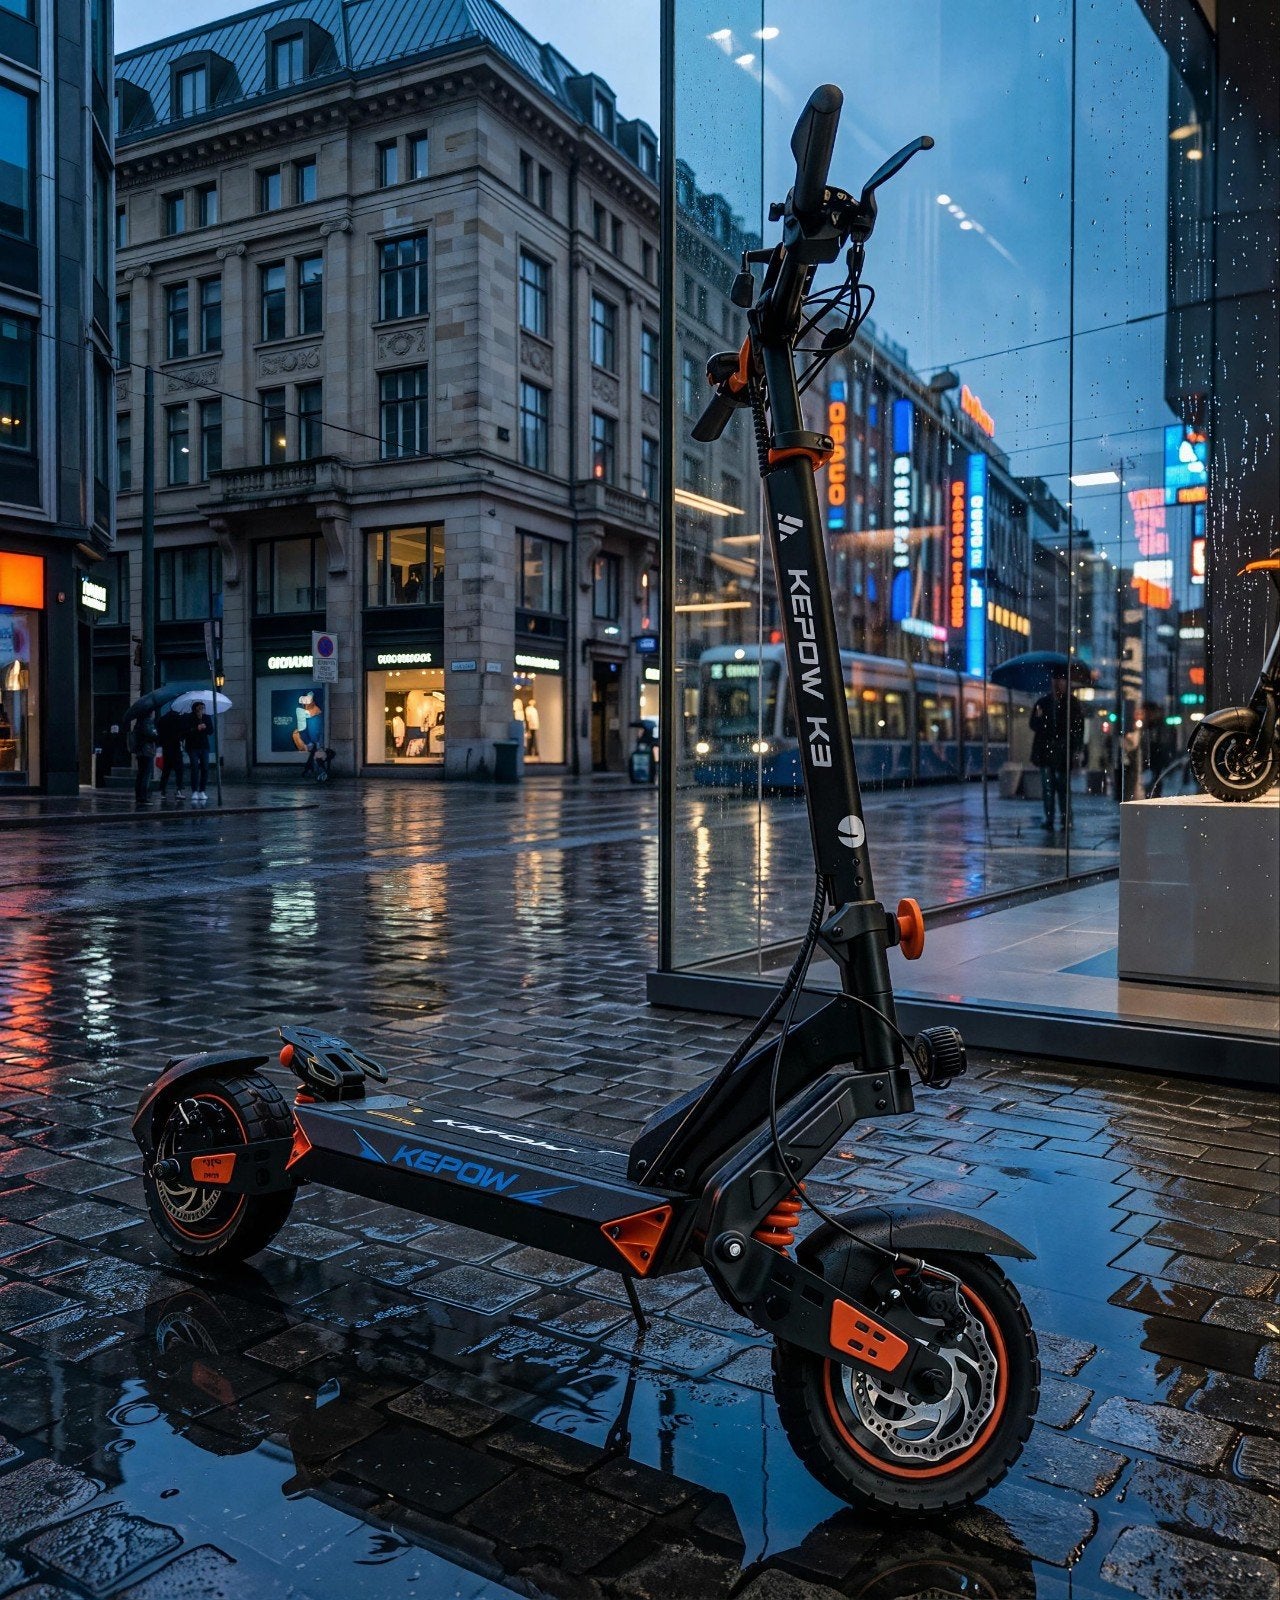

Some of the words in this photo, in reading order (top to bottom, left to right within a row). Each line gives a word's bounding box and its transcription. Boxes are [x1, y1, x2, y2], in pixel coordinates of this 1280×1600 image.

[787, 569, 824, 700] KEPOW
[806, 716, 832, 768] K3
[391, 1144, 520, 1193] KEPOW
